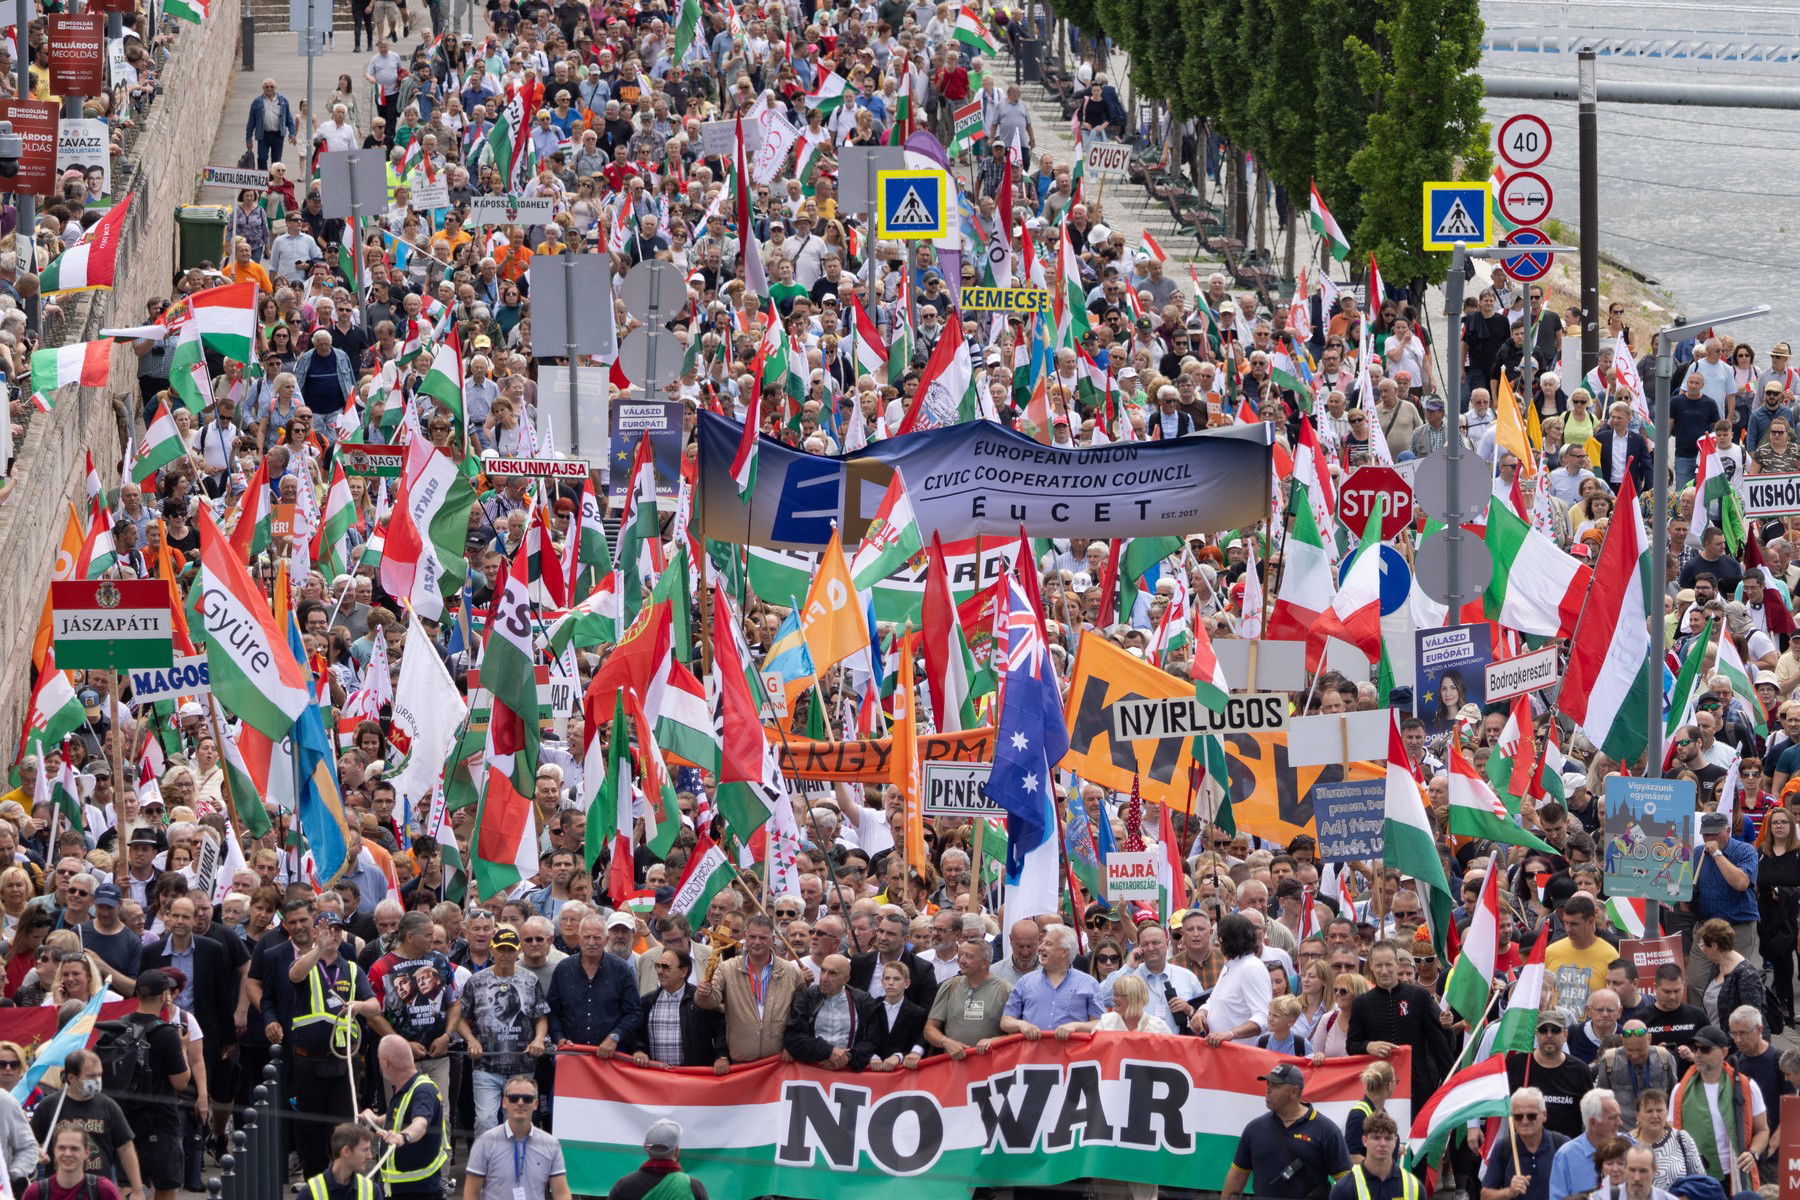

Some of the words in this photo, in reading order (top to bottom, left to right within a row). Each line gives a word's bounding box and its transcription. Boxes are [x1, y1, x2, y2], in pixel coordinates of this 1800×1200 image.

[51, 41, 99, 49] MILLIÁRDOS
[51, 50, 98, 58] MEGOLDÁS
[59, 138, 101, 147] ZAVAZZ
[1513, 131, 1538, 152] 40
[1089, 147, 1129, 170] GYUGY
[473, 200, 550, 209] KAPOSSZRDAHELY
[961, 289, 1048, 310] KEMECSE
[623, 407, 662, 416] VÁLASZD
[622, 419, 664, 428] EURÓPÁT!
[974, 440, 1071, 465] EUROPEAN
[1078, 448, 1138, 465] UNION
[370, 456, 402, 467] NAGY
[488, 460, 587, 476] KISKUNMAJSA
[924, 470, 971, 490] CIVIC
[974, 466, 1107, 489] COOPERATION
[1112, 464, 1192, 487] COUNCIL
[1342, 489, 1409, 518] STOP
[1161, 511, 1177, 520] EST.
[1179, 510, 1199, 518] 2017
[61, 614, 160, 634] JÁSZAPÁTI
[203, 589, 270, 674] Gyüre
[1425, 632, 1467, 648] VÁLASZD
[1426, 647, 1471, 663] EURÓPÁT!
[133, 662, 210, 696] MAGOS
[1490, 658, 1552, 692] Bodrogkeresztúr
[1119, 697, 1284, 737] NYÍRLOGOS
[1628, 781, 1674, 792] Vigyázzunk
[1630, 792, 1672, 801] egymásra!
[1321, 818, 1348, 838] Adj
[1349, 817, 1384, 835] fény
[1109, 878, 1157, 891] MAGYARORSZÁG!
[411, 1017, 435, 1026] WORLD
[1544, 1094, 1574, 1105] RORSZÁG
[777, 1082, 944, 1174] NO
[969, 1061, 1194, 1152] WAR
